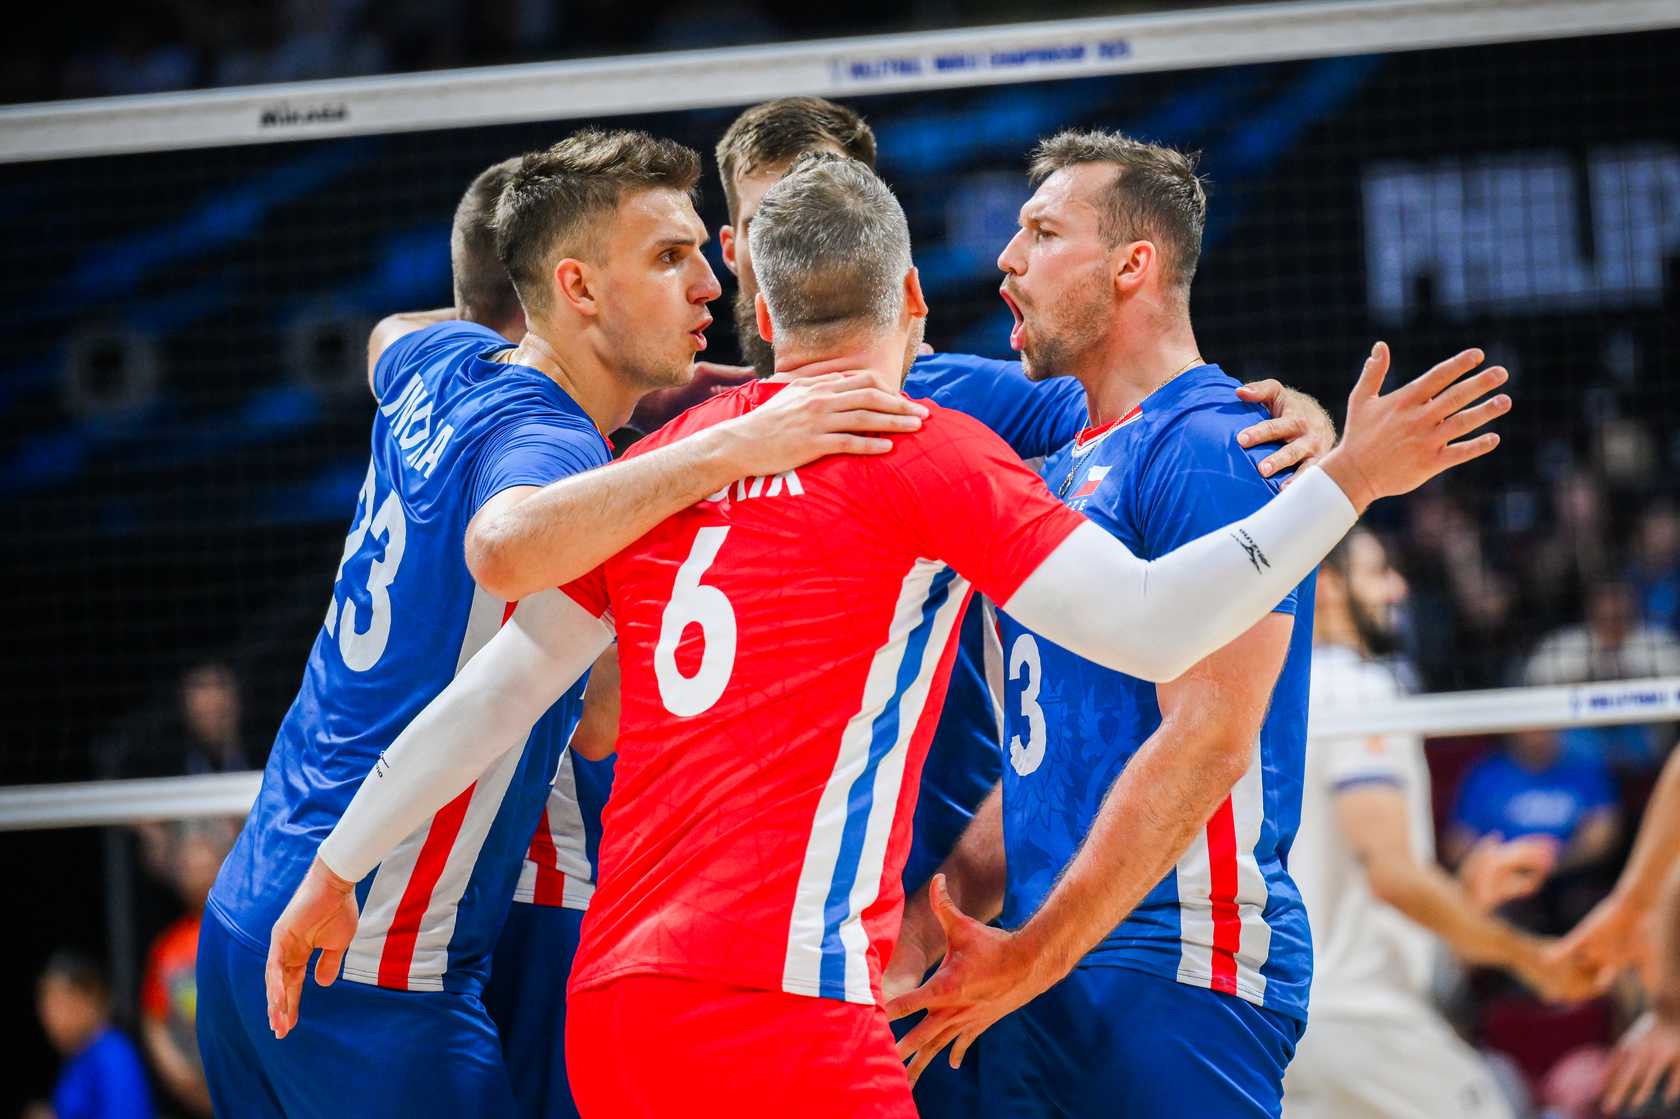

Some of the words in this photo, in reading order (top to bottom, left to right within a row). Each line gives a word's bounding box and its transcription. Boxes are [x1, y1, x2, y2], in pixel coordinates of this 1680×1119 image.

[324, 454, 407, 672] 23
[653, 525, 738, 718] 6
[1008, 633, 1047, 777] 3
